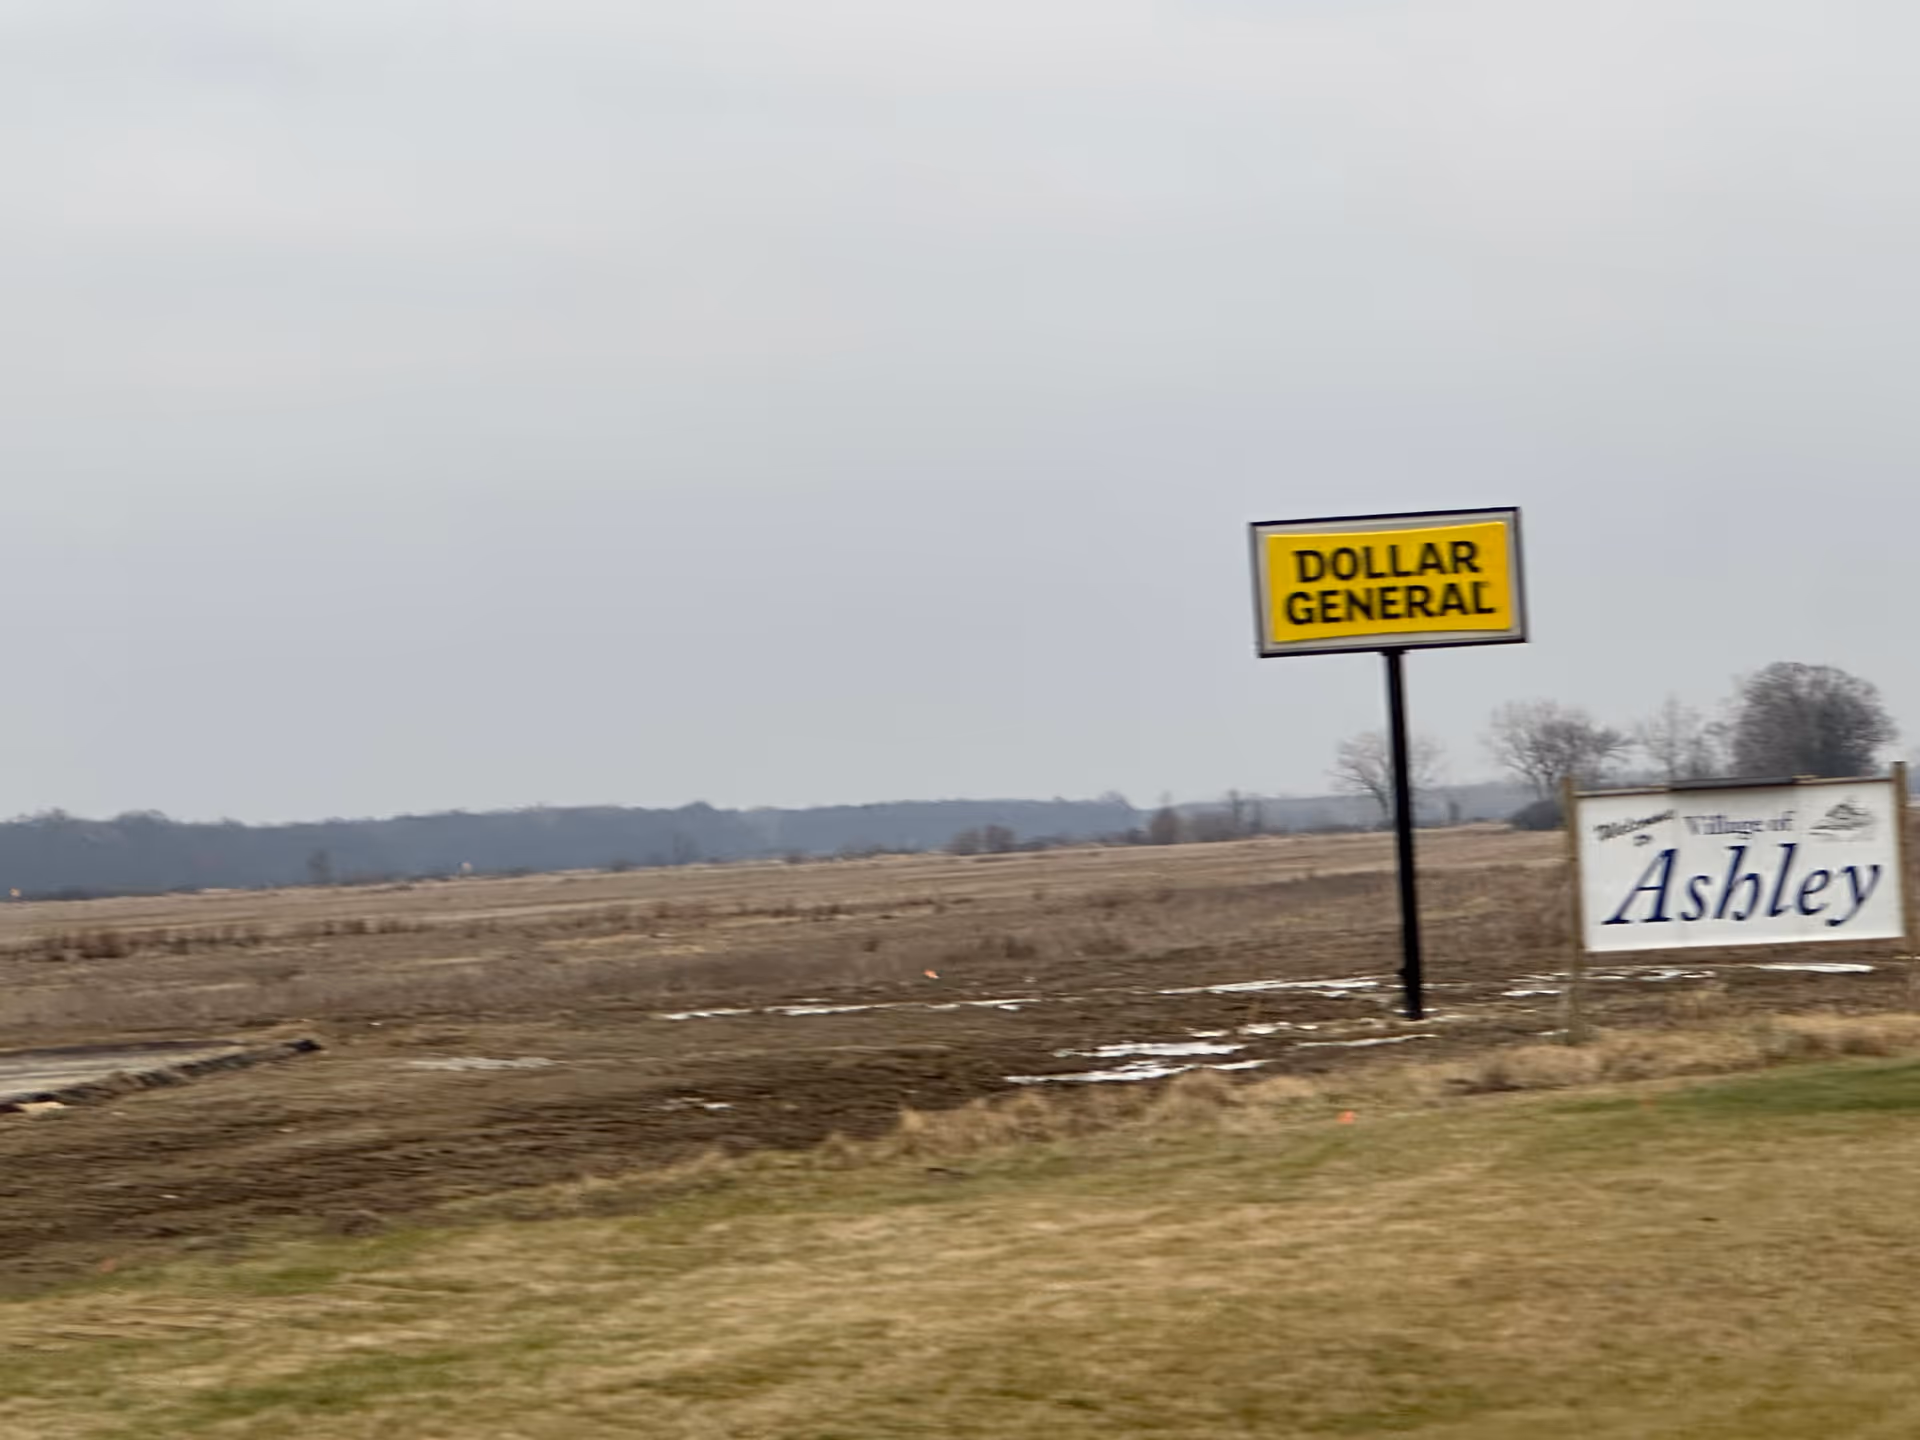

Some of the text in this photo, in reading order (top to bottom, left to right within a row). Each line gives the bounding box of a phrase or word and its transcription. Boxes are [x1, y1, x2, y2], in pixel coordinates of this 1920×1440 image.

[1292, 541, 1480, 583] DOLLAR
[1286, 581, 1497, 625] GENERAL
[1684, 815, 1763, 840] Village
[1768, 811, 1795, 832] of
[1602, 843, 1881, 927] Ashley
